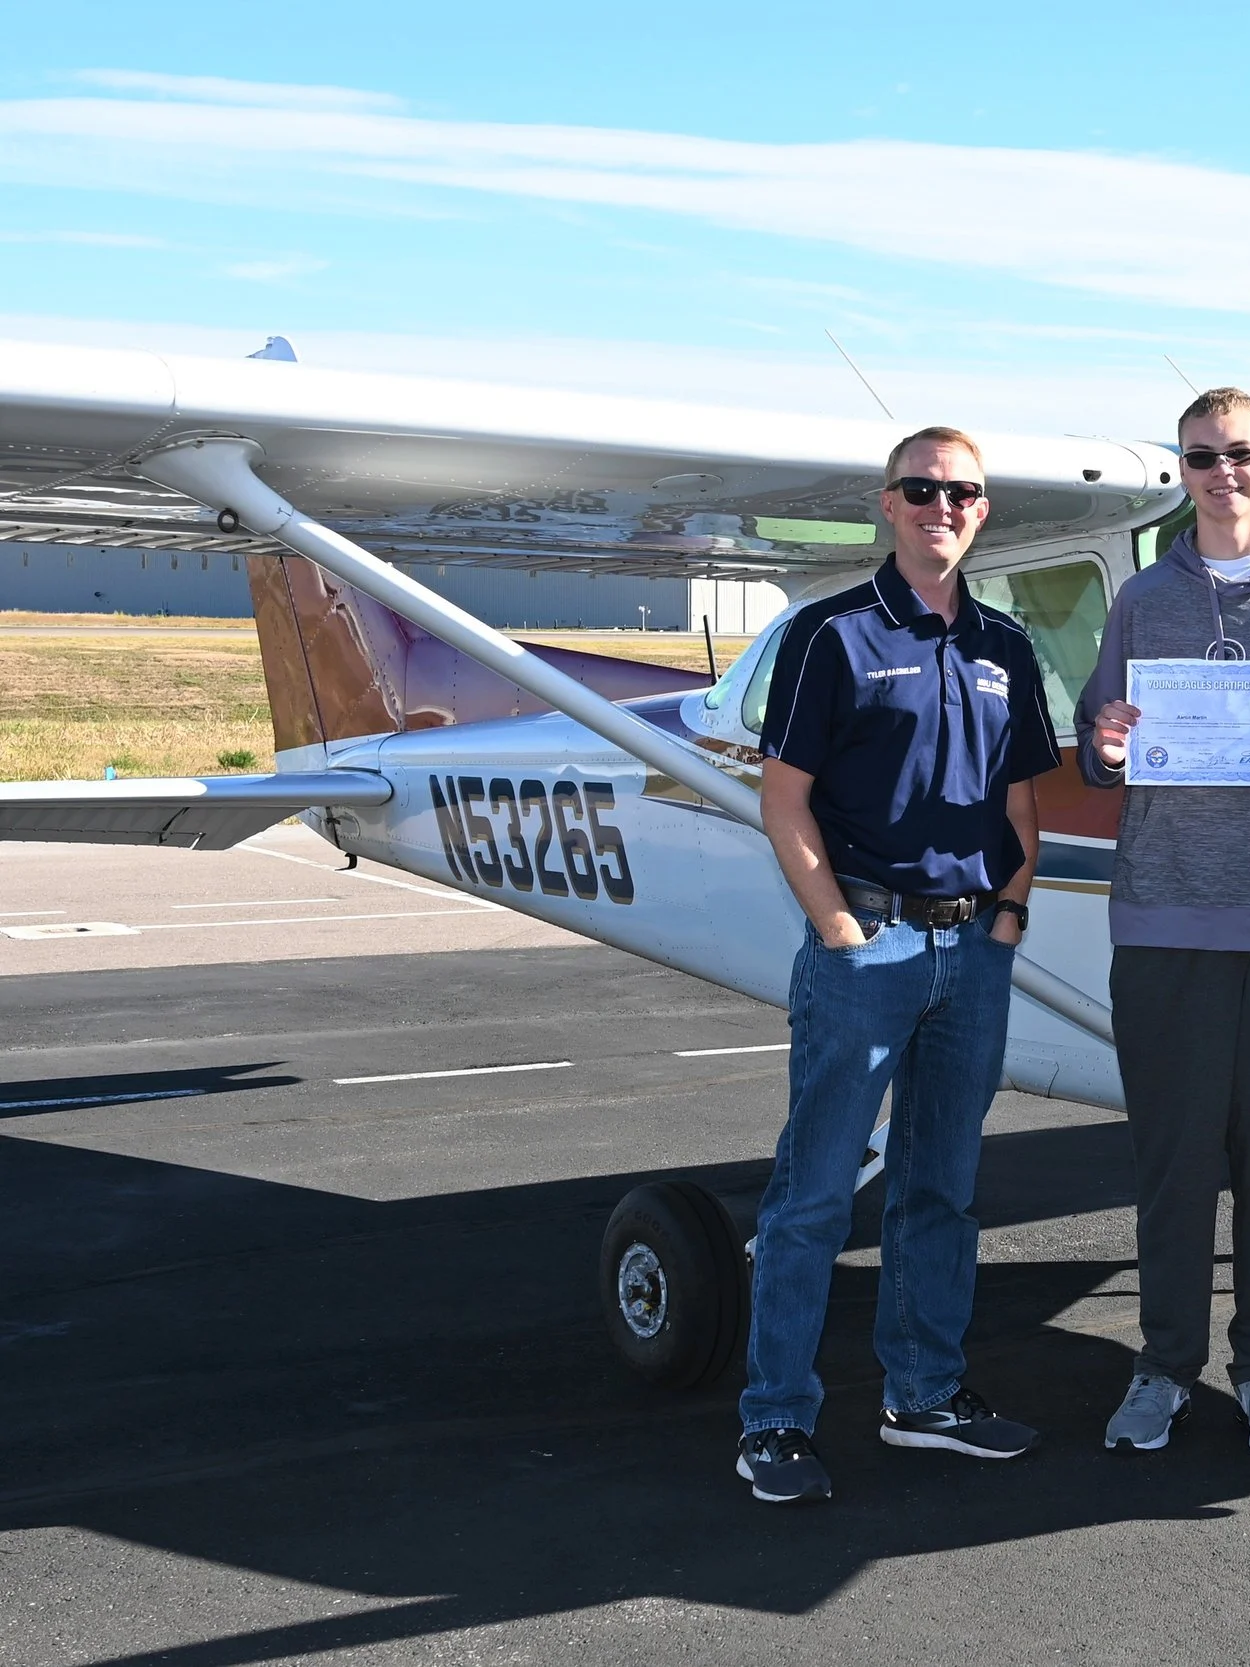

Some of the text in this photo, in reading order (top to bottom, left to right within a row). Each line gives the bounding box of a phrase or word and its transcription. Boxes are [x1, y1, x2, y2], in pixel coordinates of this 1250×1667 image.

[866, 670, 886, 679] TYLER
[1147, 680, 1178, 690] YOUNG
[1180, 680, 1212, 690] EAGLES
[429, 774, 634, 905] N53265
